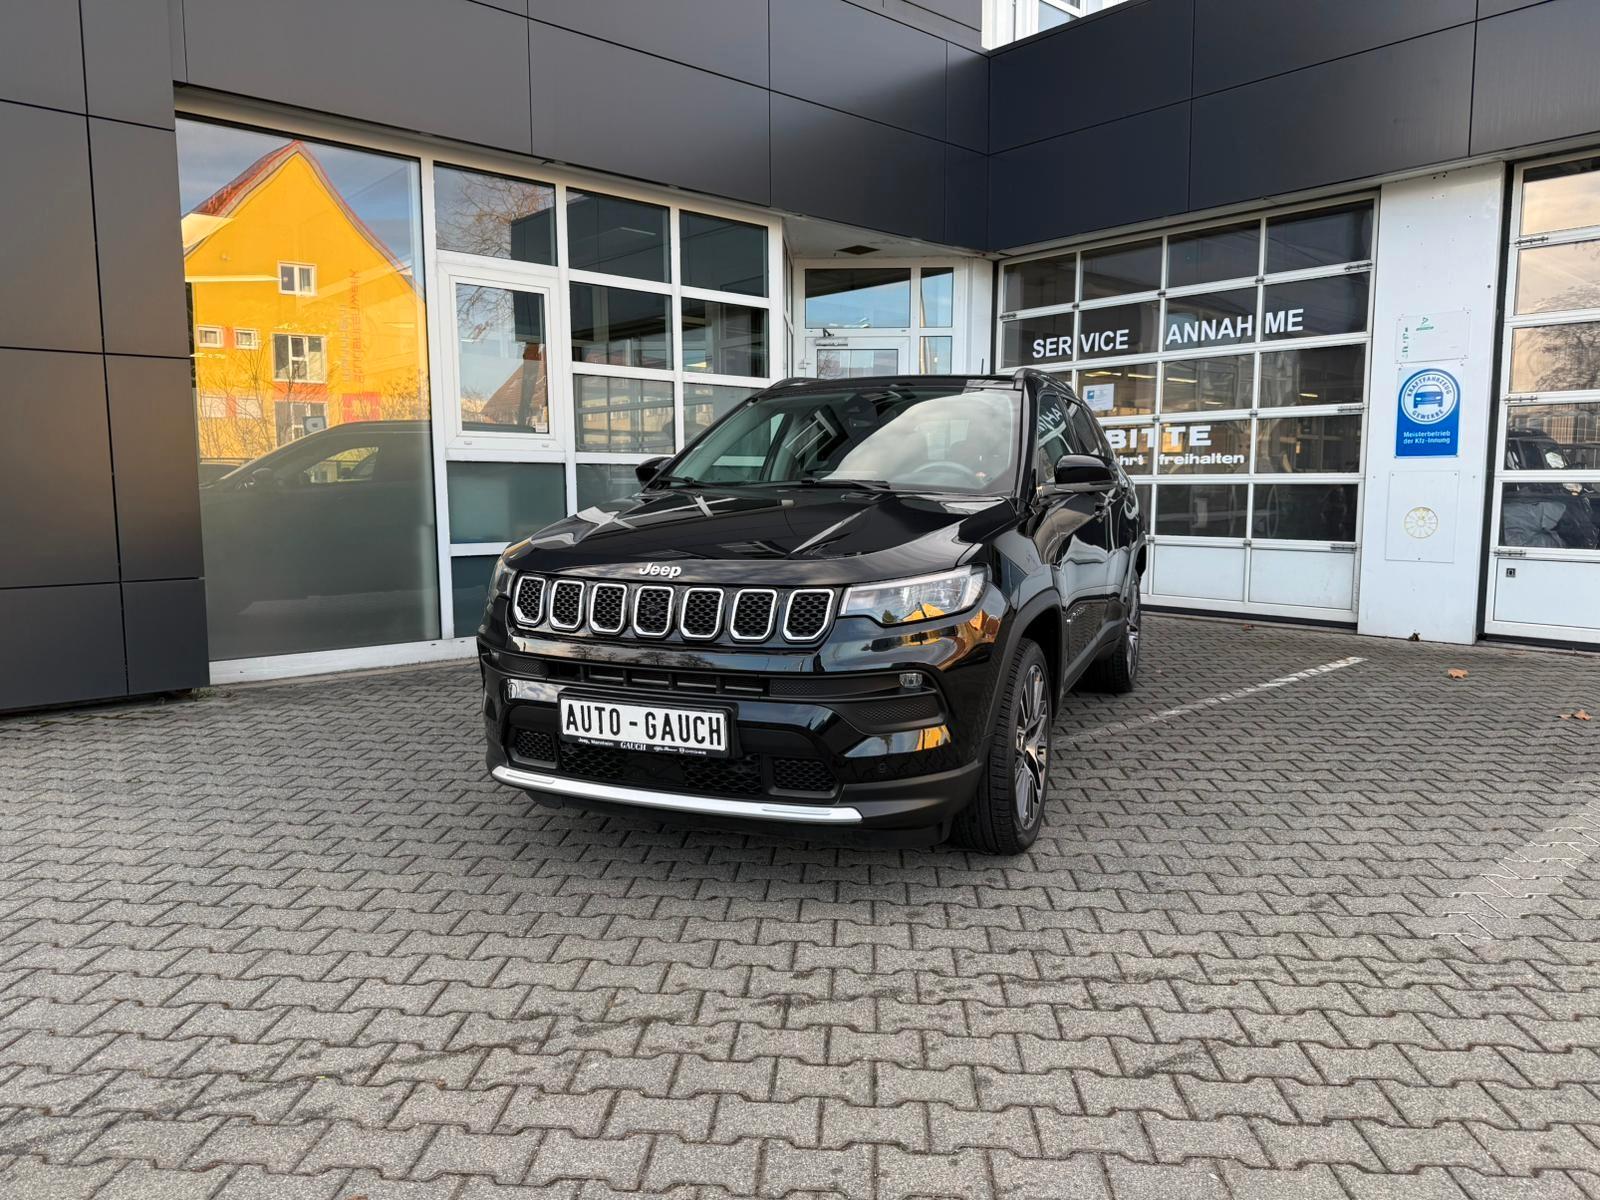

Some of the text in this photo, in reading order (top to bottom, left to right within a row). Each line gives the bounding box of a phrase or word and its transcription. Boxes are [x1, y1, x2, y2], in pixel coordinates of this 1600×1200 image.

[1032, 308, 1304, 358] SERVICE ANNAHME
[1105, 425, 1212, 449] BITTE
[1403, 430, 1451, 438] Meisterbetrieb
[1159, 453, 1245, 465] freihalten
[638, 562, 682, 578] Jeep
[566, 703, 722, 747] AUTO - GAUCH
[620, 742, 647, 751] GAUCH
